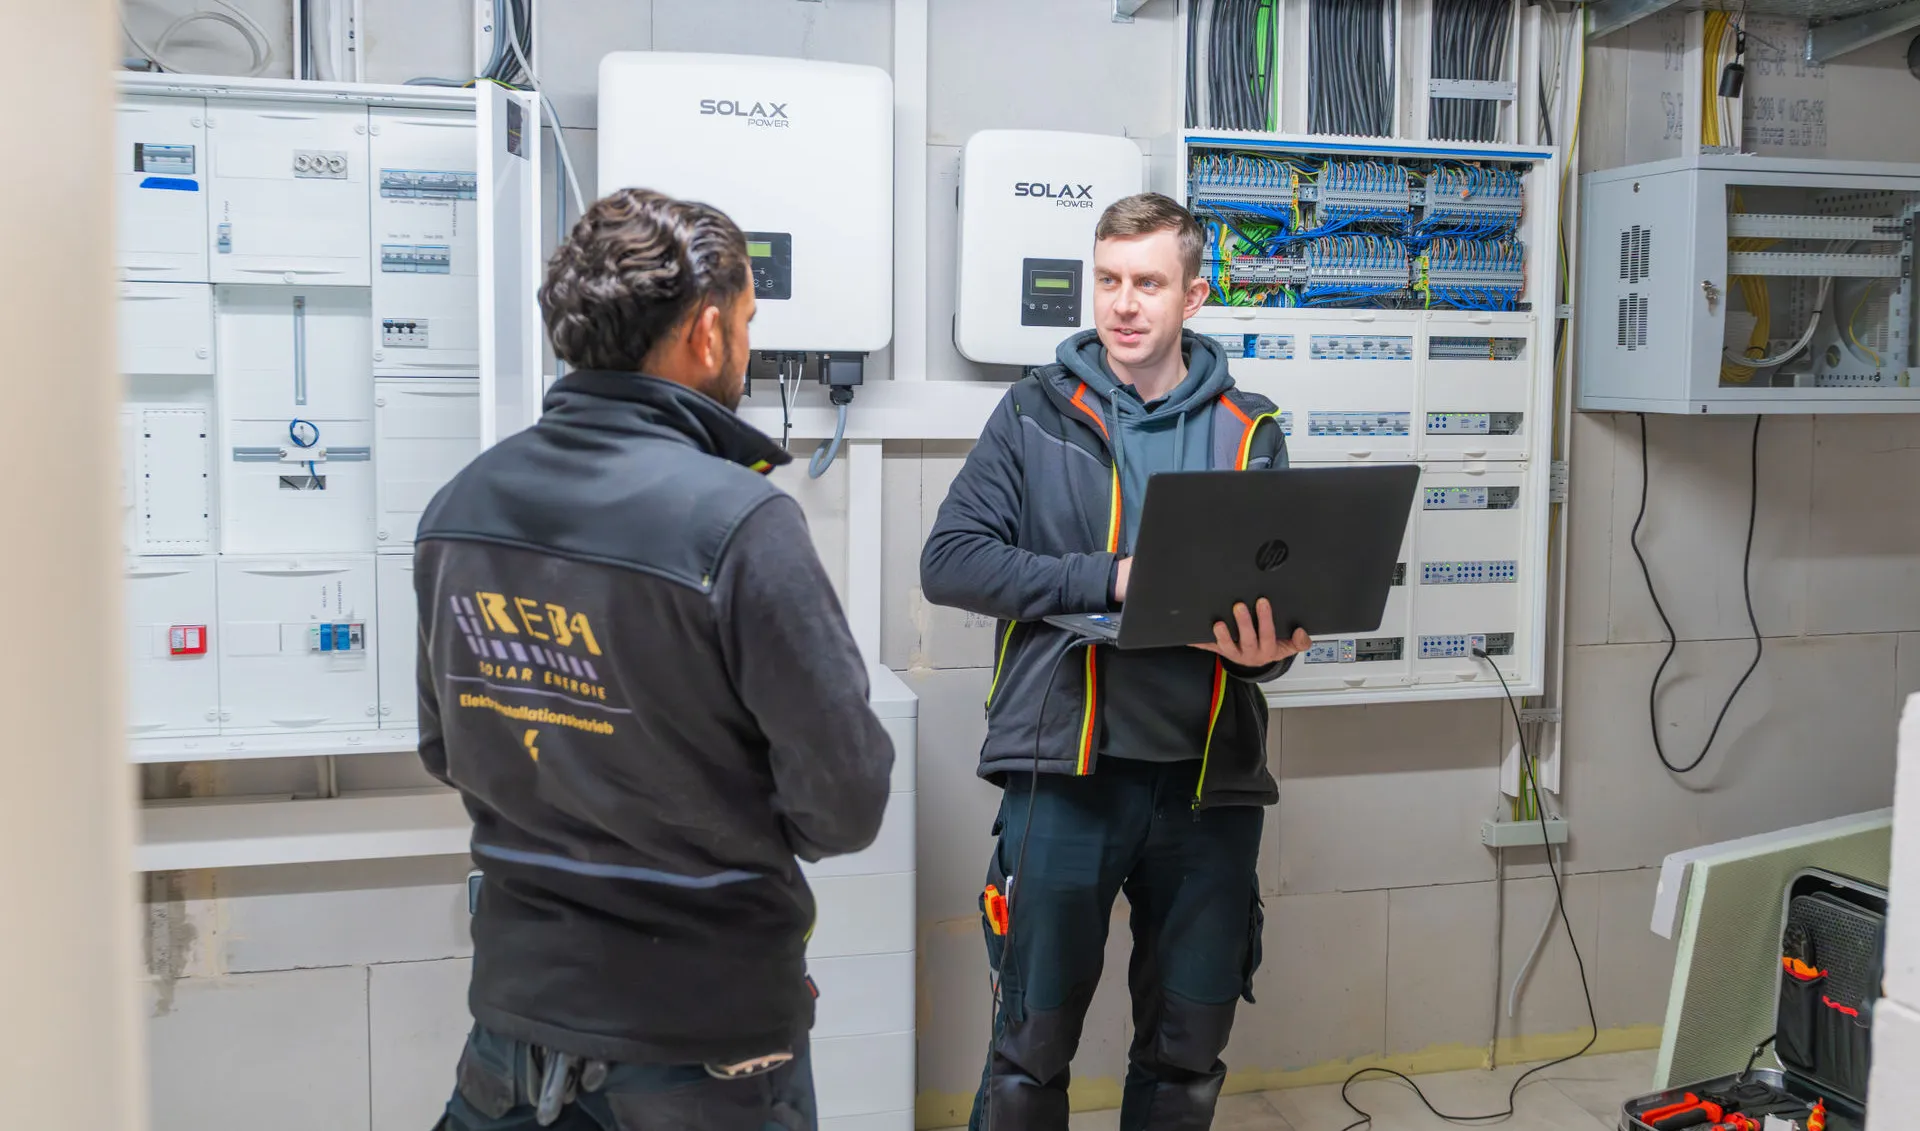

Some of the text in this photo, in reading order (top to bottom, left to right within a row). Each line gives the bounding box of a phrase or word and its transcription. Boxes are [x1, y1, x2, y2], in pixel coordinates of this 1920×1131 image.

[700, 99, 788, 119] SOLAX
[747, 118, 789, 128] POWER
[1015, 182, 1093, 200] SOLAX
[1056, 199, 1093, 209] POWER
[475, 591, 603, 656] REBA
[479, 660, 606, 700] SOLAR ENERGIE
[459, 694, 614, 735] Elektrnstallationsbetrieb
